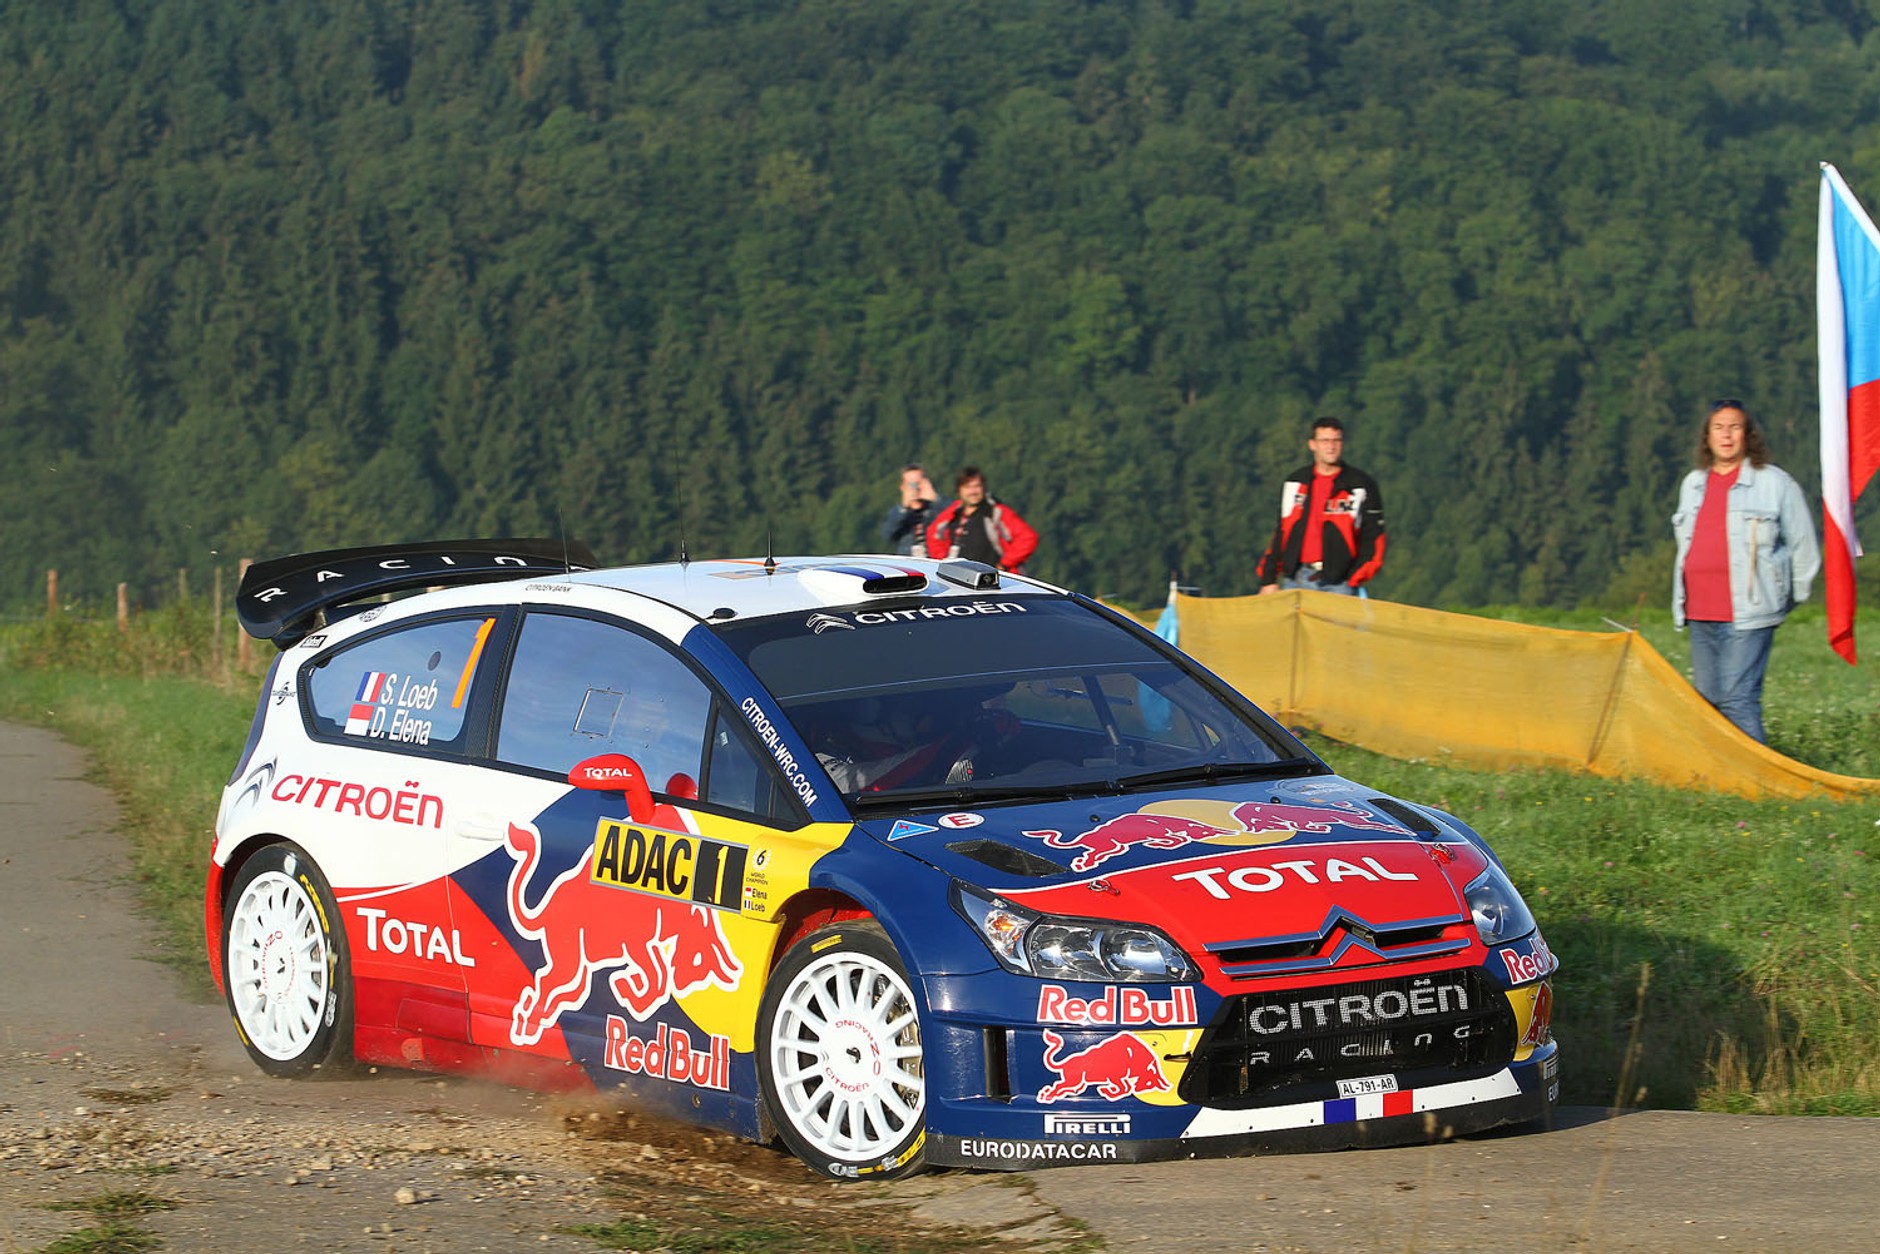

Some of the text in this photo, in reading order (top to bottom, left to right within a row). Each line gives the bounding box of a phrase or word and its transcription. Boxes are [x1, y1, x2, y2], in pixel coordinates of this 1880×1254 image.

[853, 601, 1027, 625] CITROËN
[451, 617, 496, 708] 1
[381, 673, 438, 711] S. Loeb
[371, 708, 432, 745] D. Elena
[741, 697, 818, 808] CITROEN-WRC.COM
[584, 767, 632, 778] TOTAL
[271, 774, 443, 829] CITROËN
[947, 815, 975, 827] E
[596, 825, 729, 905] ADAC 1
[1172, 857, 1419, 899] TOTAL
[751, 900, 765, 912] Loeb
[752, 888, 767, 899] Elena
[356, 907, 475, 967] TOTAL
[1036, 984, 1198, 1025] Red Bull
[1249, 979, 1468, 1034] CITROËN
[605, 1014, 730, 1091] Red Bull
[1342, 1077, 1394, 1094] AL-791-AR
[1044, 1114, 1131, 1134] PIRELLI
[960, 1139, 1117, 1160] EURODATACAR
